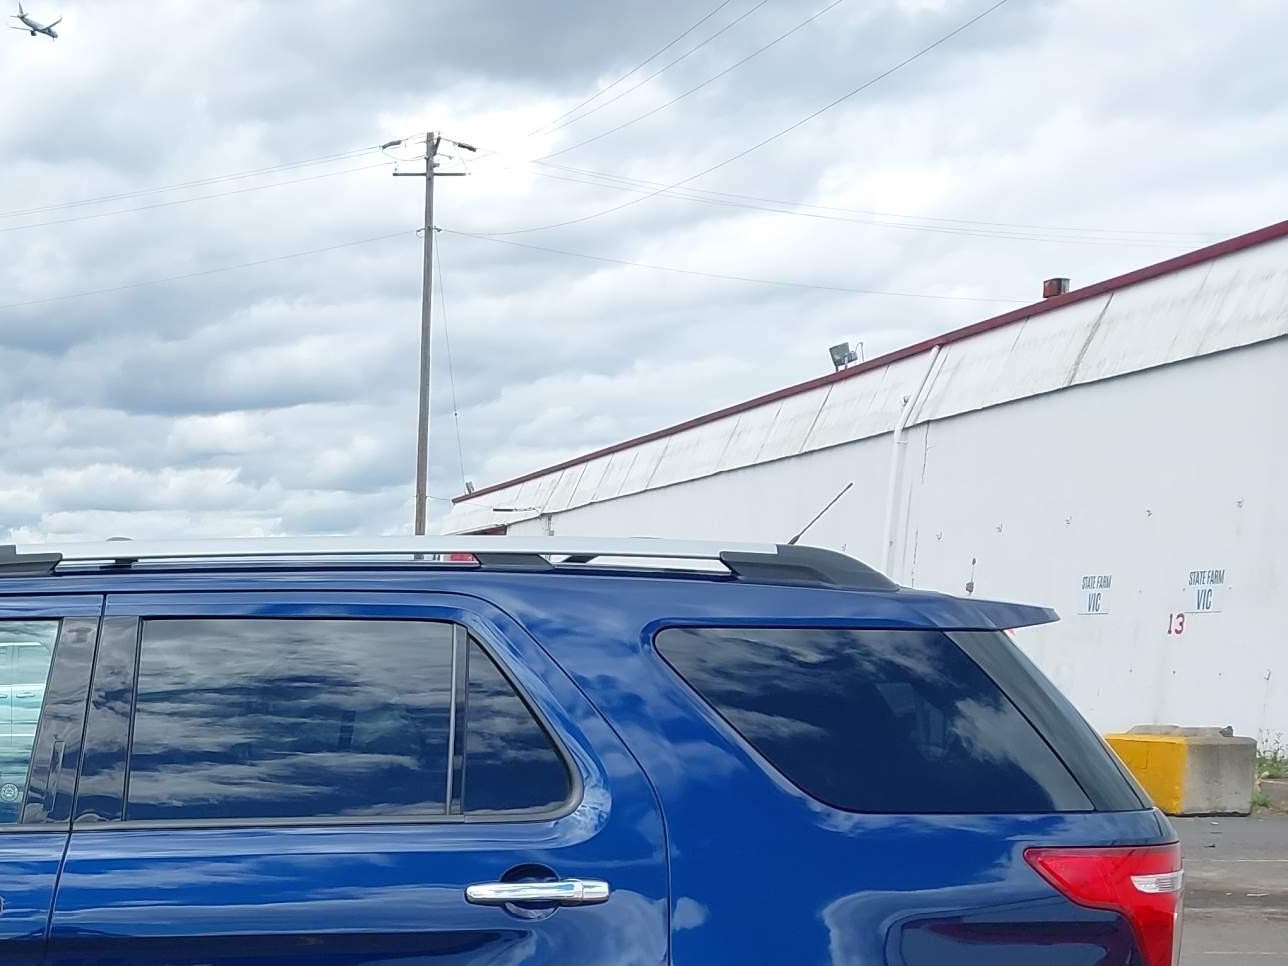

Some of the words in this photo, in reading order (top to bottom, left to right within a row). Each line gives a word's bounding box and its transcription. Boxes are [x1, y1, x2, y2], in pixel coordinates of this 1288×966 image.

[1082, 576, 1096, 590] STATE
[1096, 575, 1112, 589] FARM
[1189, 571, 1207, 586] STATE
[1207, 569, 1225, 585] FARM
[1088, 592, 1102, 612] VIC
[1197, 588, 1213, 610] VIC
[1167, 613, 1185, 635] 13
